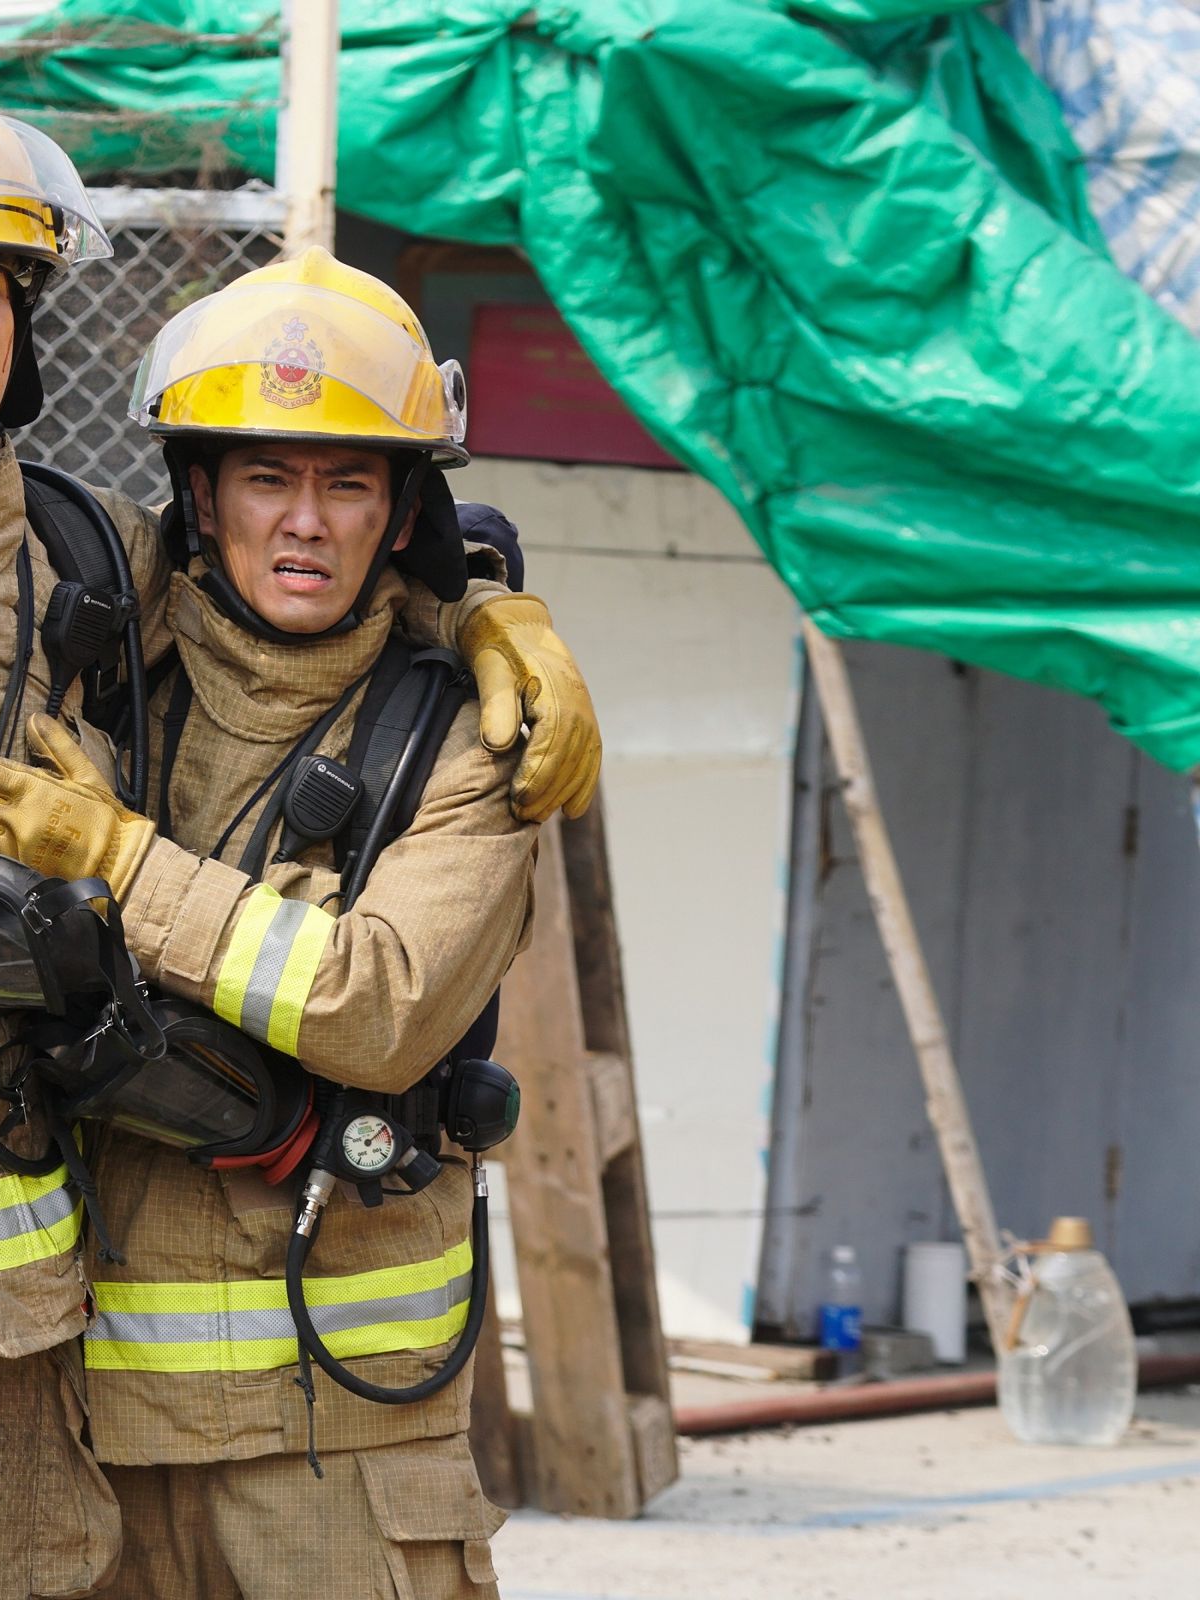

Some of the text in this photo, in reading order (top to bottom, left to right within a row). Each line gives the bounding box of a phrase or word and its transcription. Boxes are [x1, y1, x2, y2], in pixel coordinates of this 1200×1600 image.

[267, 393, 314, 408] HONG KONG
[326, 770, 354, 791] MOTOROLA
[51, 825, 82, 860] FIRE
